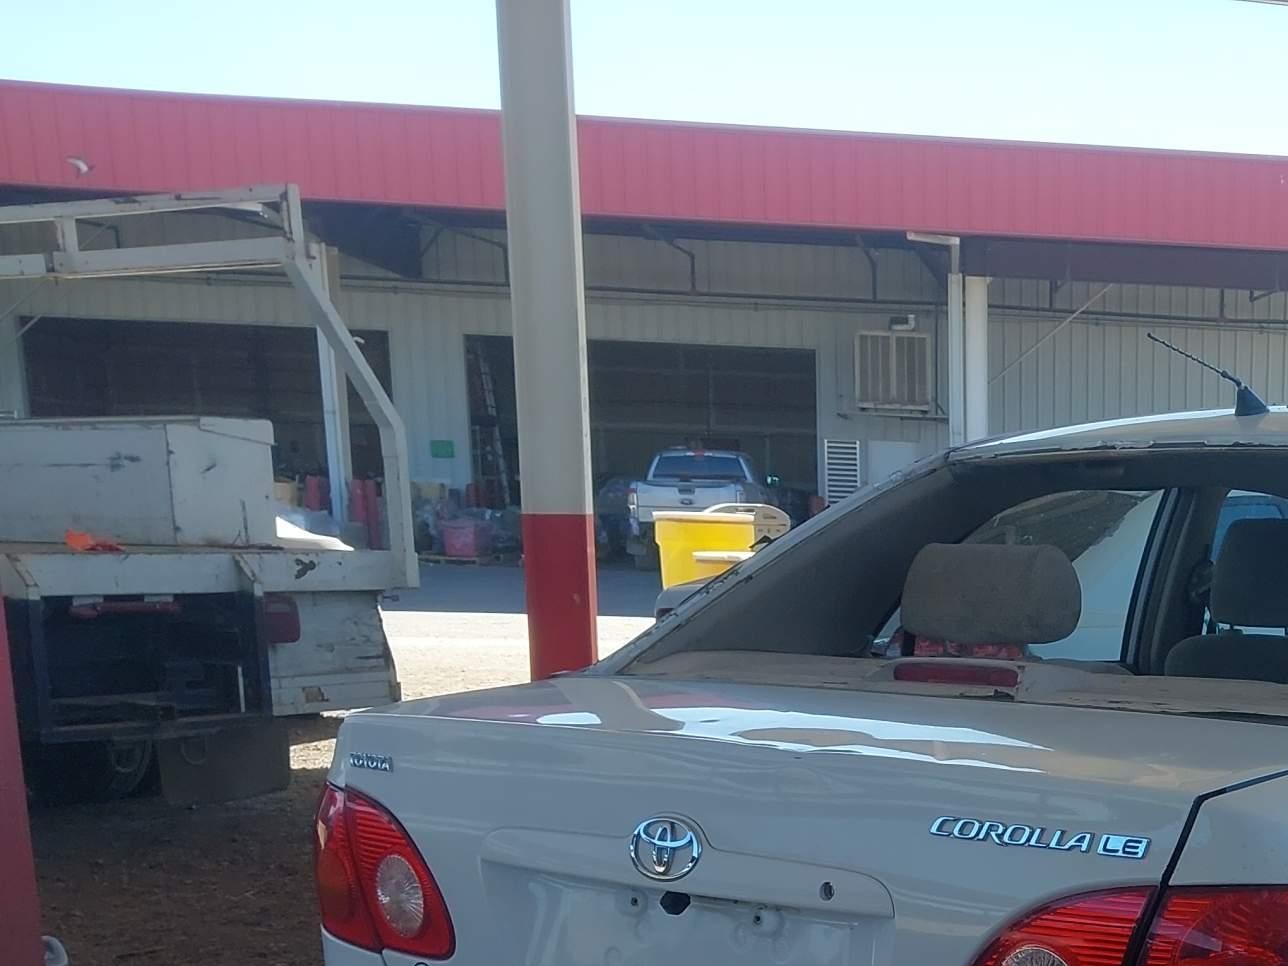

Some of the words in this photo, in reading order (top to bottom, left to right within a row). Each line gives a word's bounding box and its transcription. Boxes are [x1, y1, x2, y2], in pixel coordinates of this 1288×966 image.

[350, 752, 391, 771] TOYOTA
[929, 816, 1094, 852] COROLLA
[1099, 835, 1148, 857] LE
